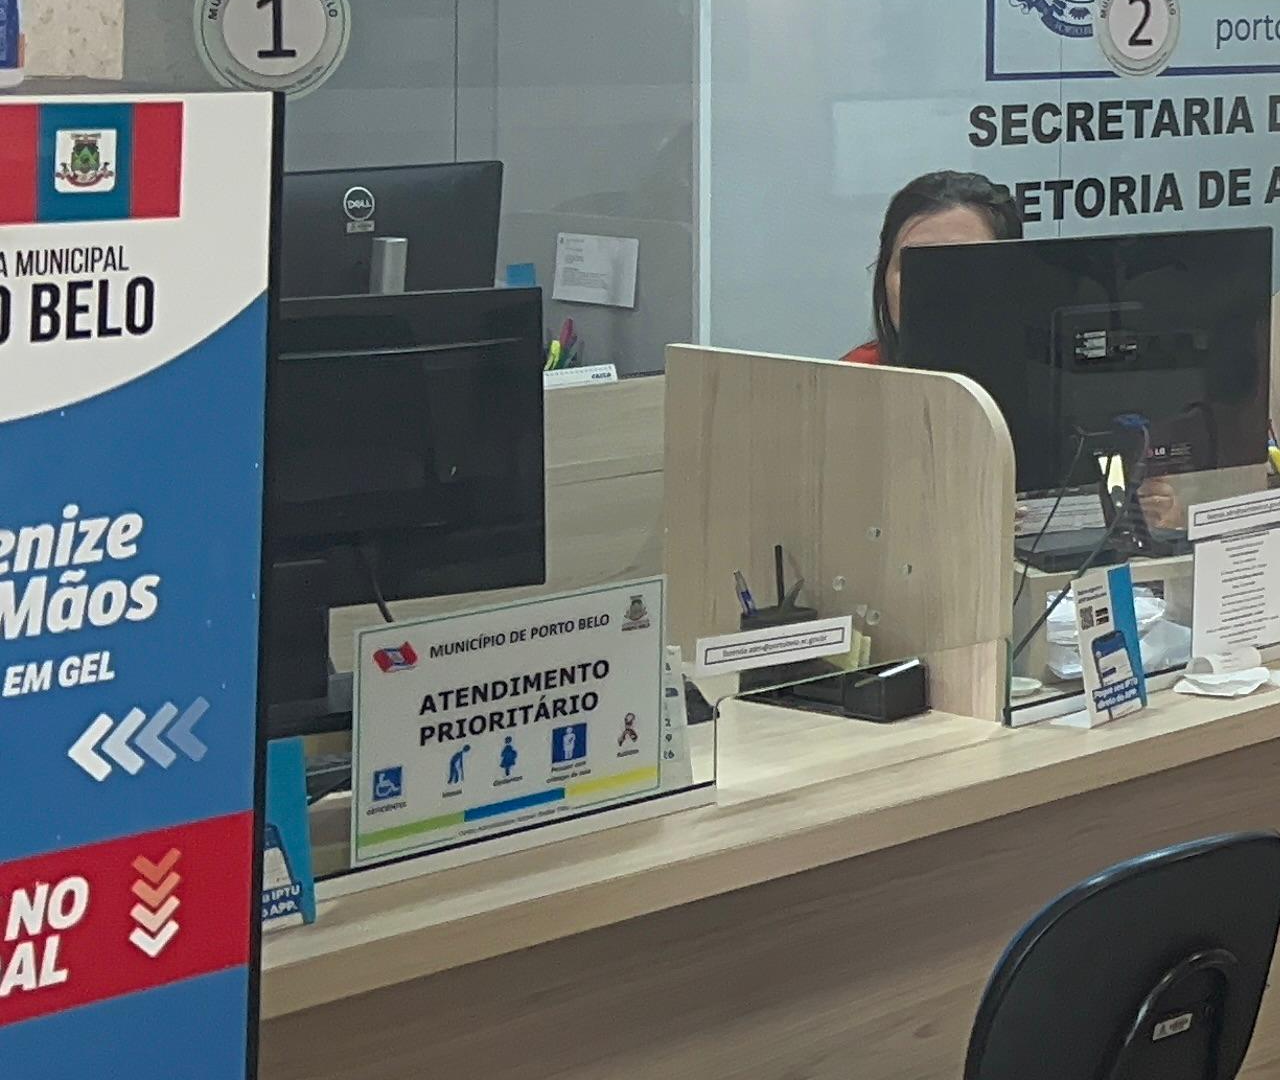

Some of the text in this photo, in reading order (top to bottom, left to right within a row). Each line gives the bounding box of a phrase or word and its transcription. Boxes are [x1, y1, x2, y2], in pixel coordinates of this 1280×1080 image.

[968, 96, 1254, 148] SECRETARIA
[348, 200, 371, 209] DELL
[1015, 173, 1182, 222] ETORIA
[1199, 167, 1252, 209] DE
[16, 245, 129, 277] MUNICIPAL
[30, 275, 155, 343] BELO
[0, 570, 161, 640] Mãos
[430, 632, 506, 659] MUNICÍPIO
[509, 628, 526, 645] DE
[530, 620, 575, 638] PORTO
[578, 614, 610, 631] BELO
[2, 651, 115, 697] EM GEL
[419, 659, 611, 716] ATENDIMENTO
[419, 691, 599, 747] PRIORITÁRIO
[5, 876, 89, 941] NO
[271, 884, 300, 900] IPTU
[0, 934, 68, 997] AL
